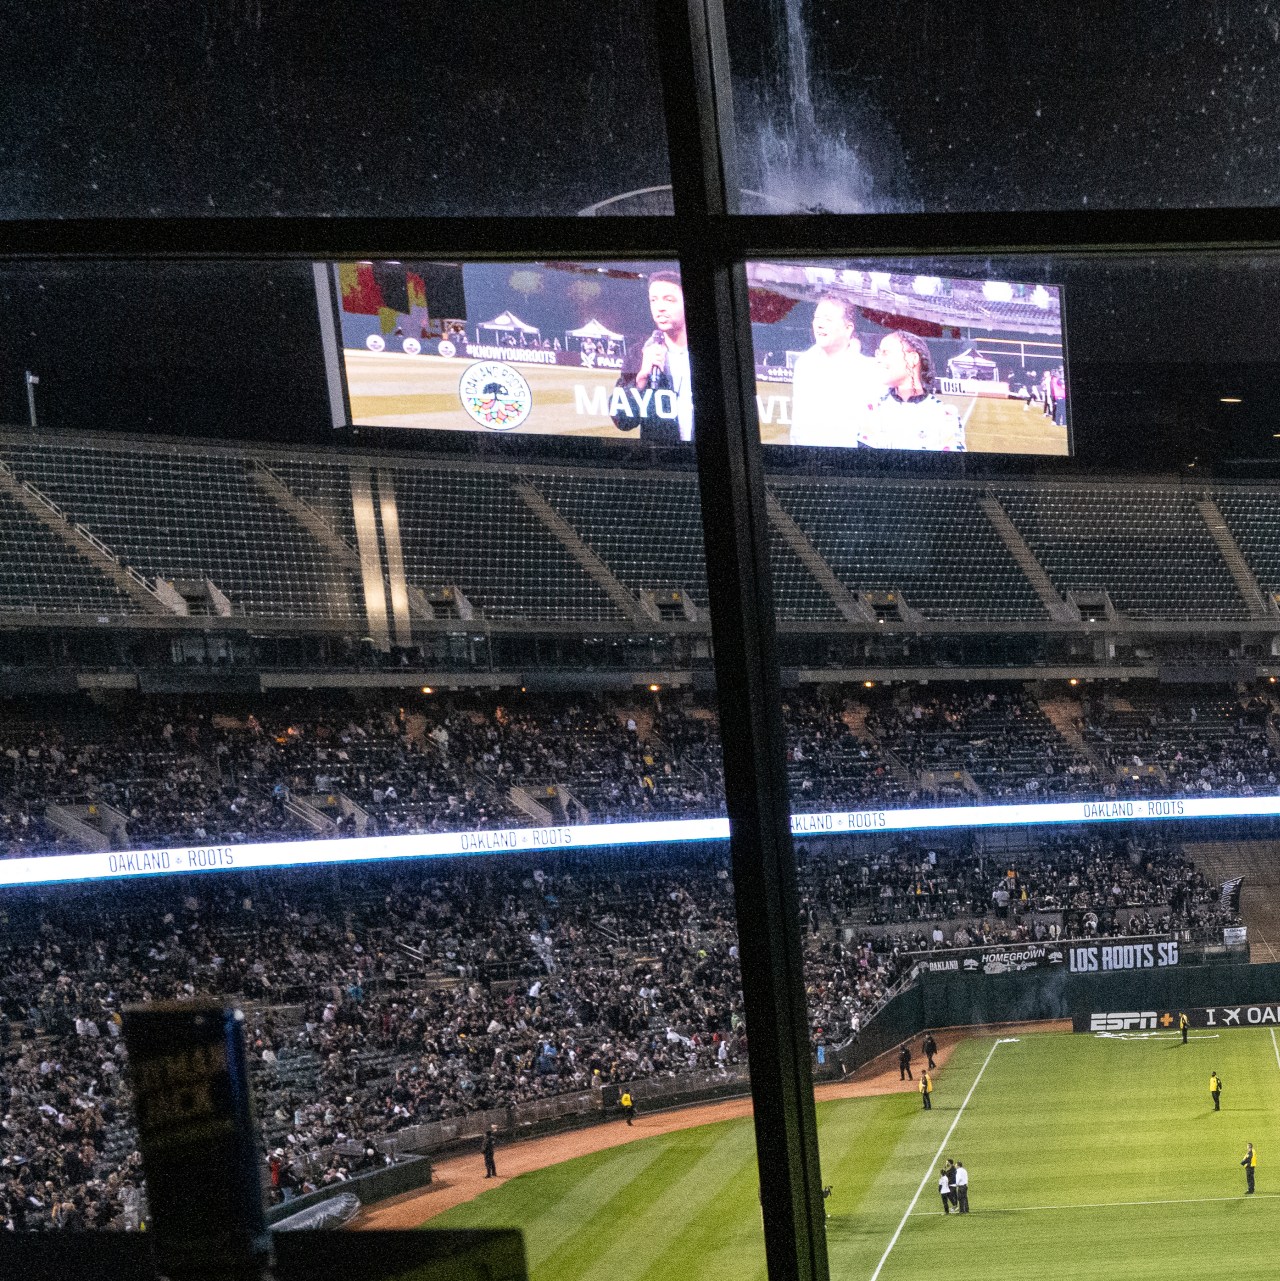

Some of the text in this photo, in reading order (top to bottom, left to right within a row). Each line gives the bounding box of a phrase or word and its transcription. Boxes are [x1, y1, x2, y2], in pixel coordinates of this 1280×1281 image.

[573, 384, 679, 420] MAYO
[1083, 801, 1184, 817] OAKLAND ROOTS
[848, 813, 886, 828] ROOTS
[460, 829, 572, 850] OAKLAND ROOTS
[108, 848, 234, 872] OAKLAND ROOTS
[981, 949, 1046, 963] HOMEGROWN
[1069, 941, 1179, 972] LOS ROOTS SG
[929, 960, 959, 972] OAKLAND
[1206, 1008, 1217, 1026] I
